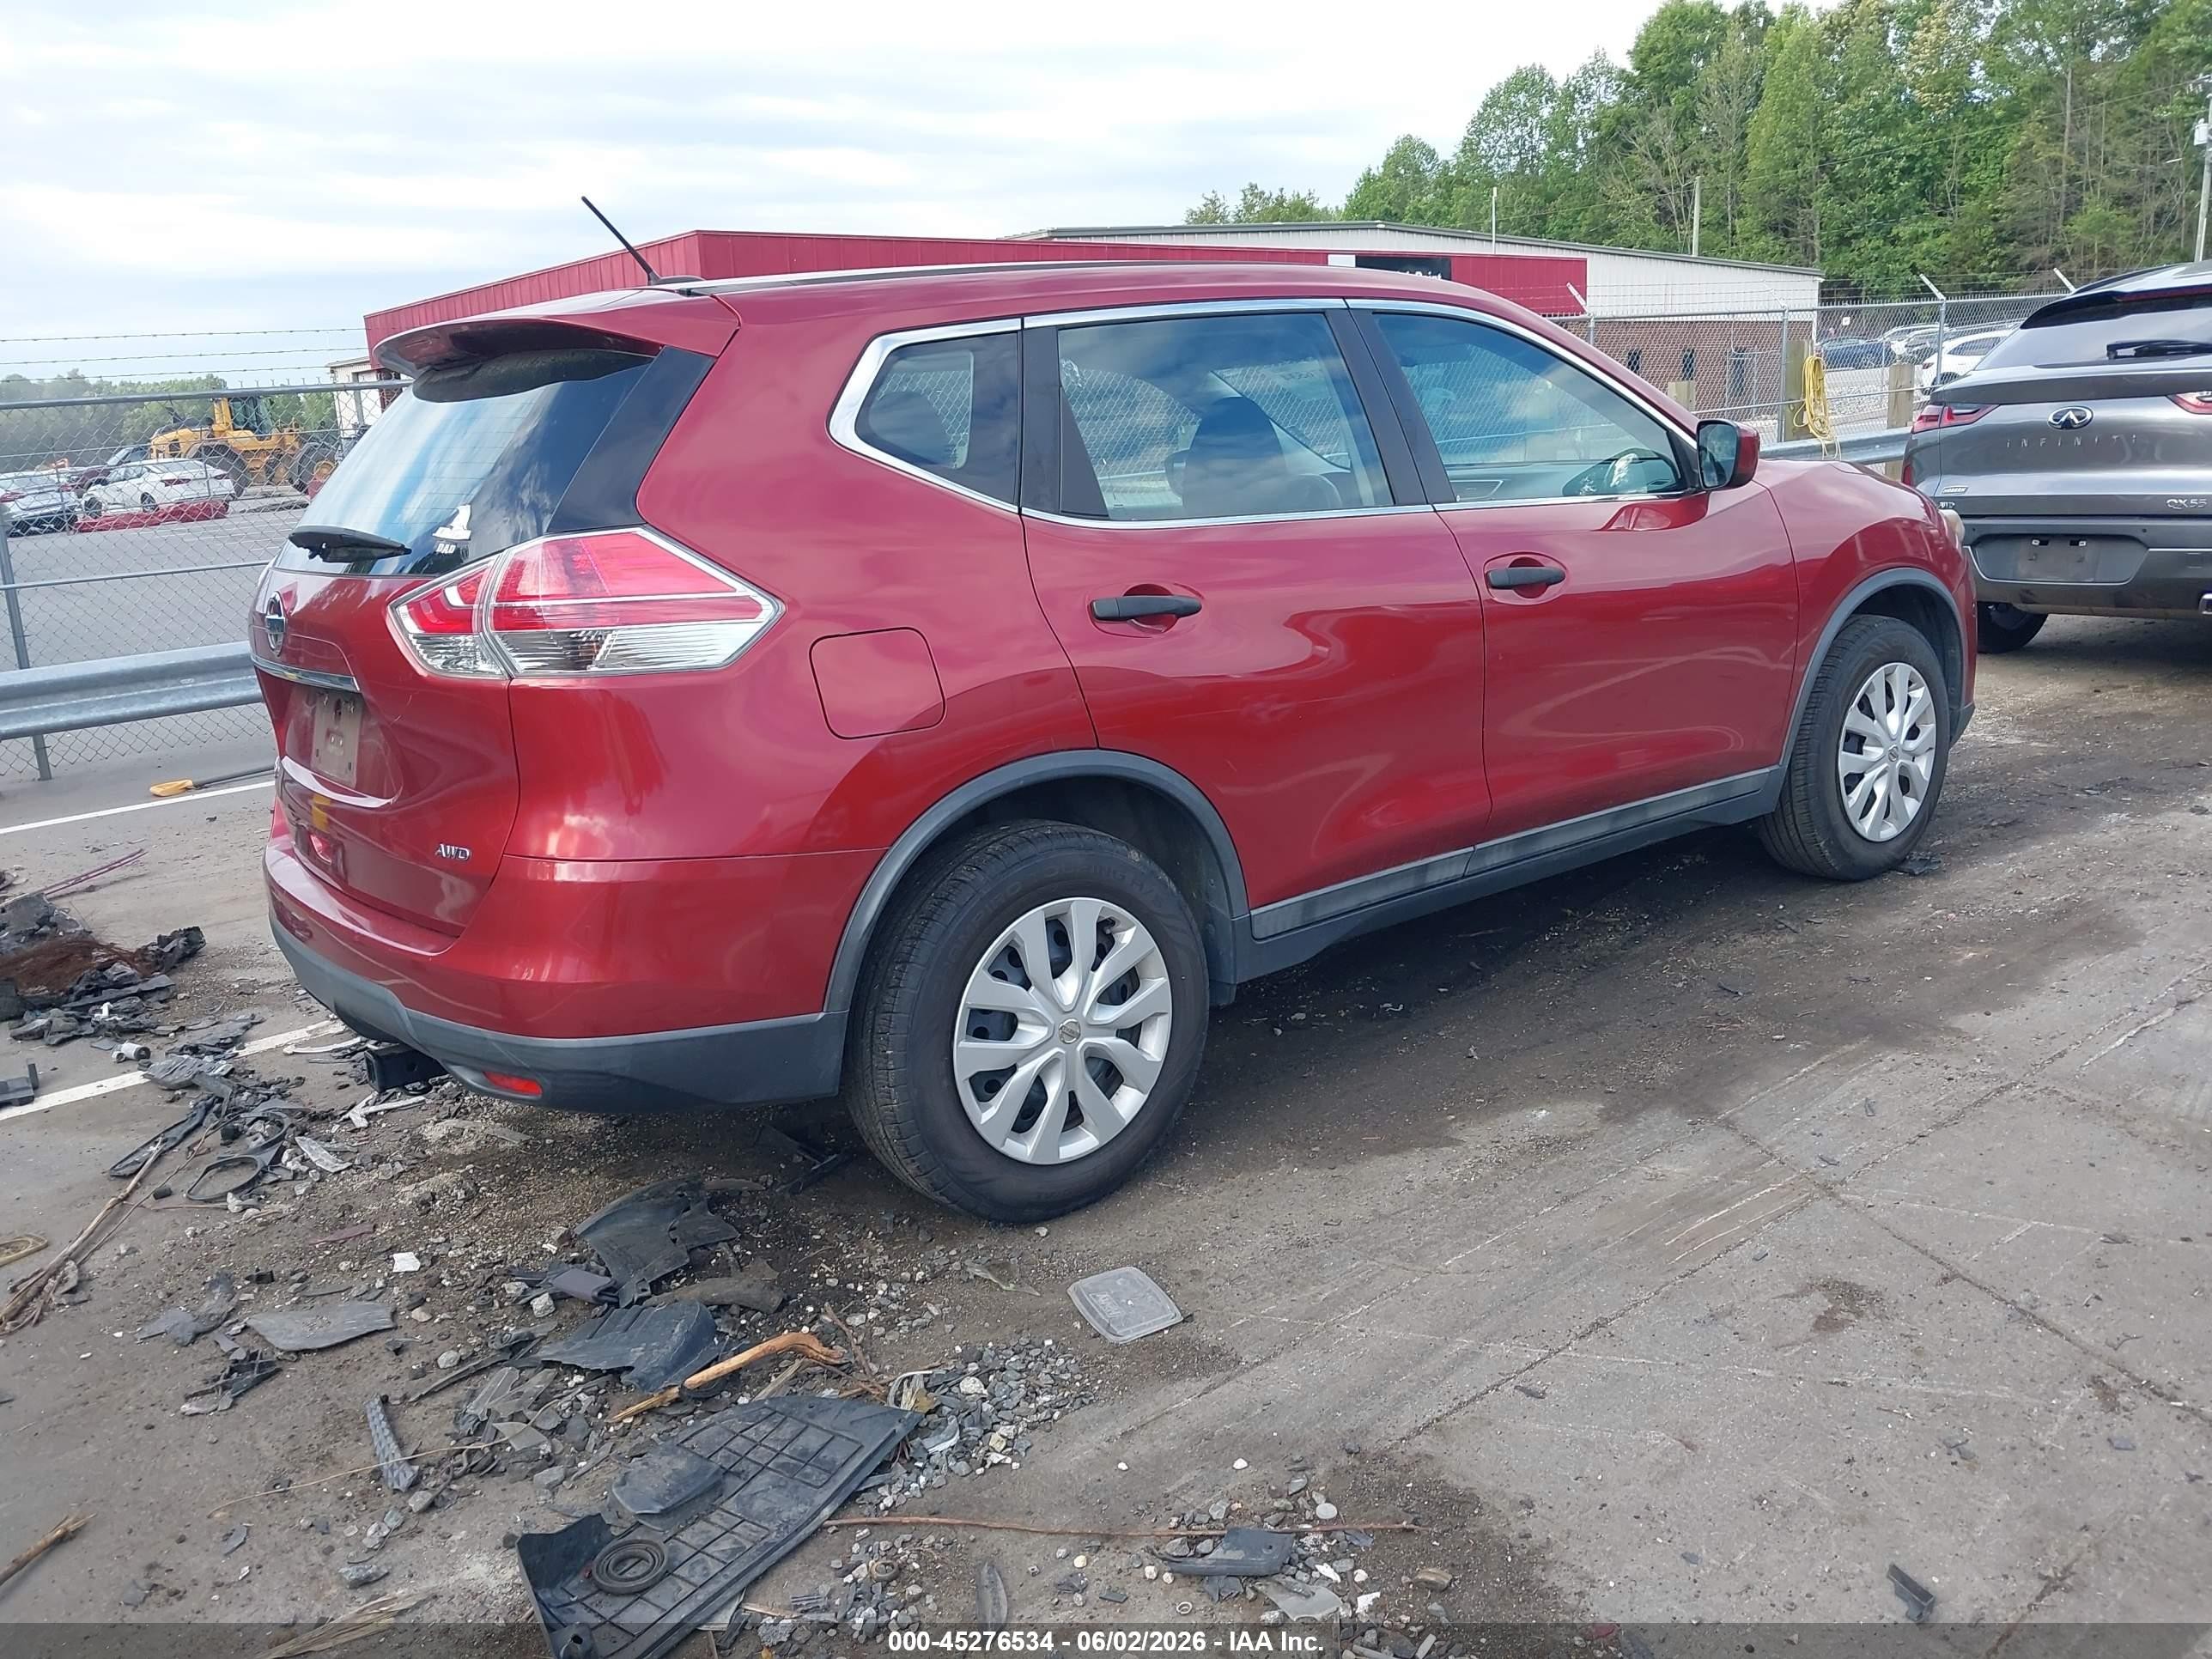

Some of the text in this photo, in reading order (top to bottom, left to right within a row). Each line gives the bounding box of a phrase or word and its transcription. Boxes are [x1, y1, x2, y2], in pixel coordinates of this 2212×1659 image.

[2166, 498, 2208, 510] QX55
[436, 543, 457, 554] DAD
[434, 843, 471, 861] AWD
